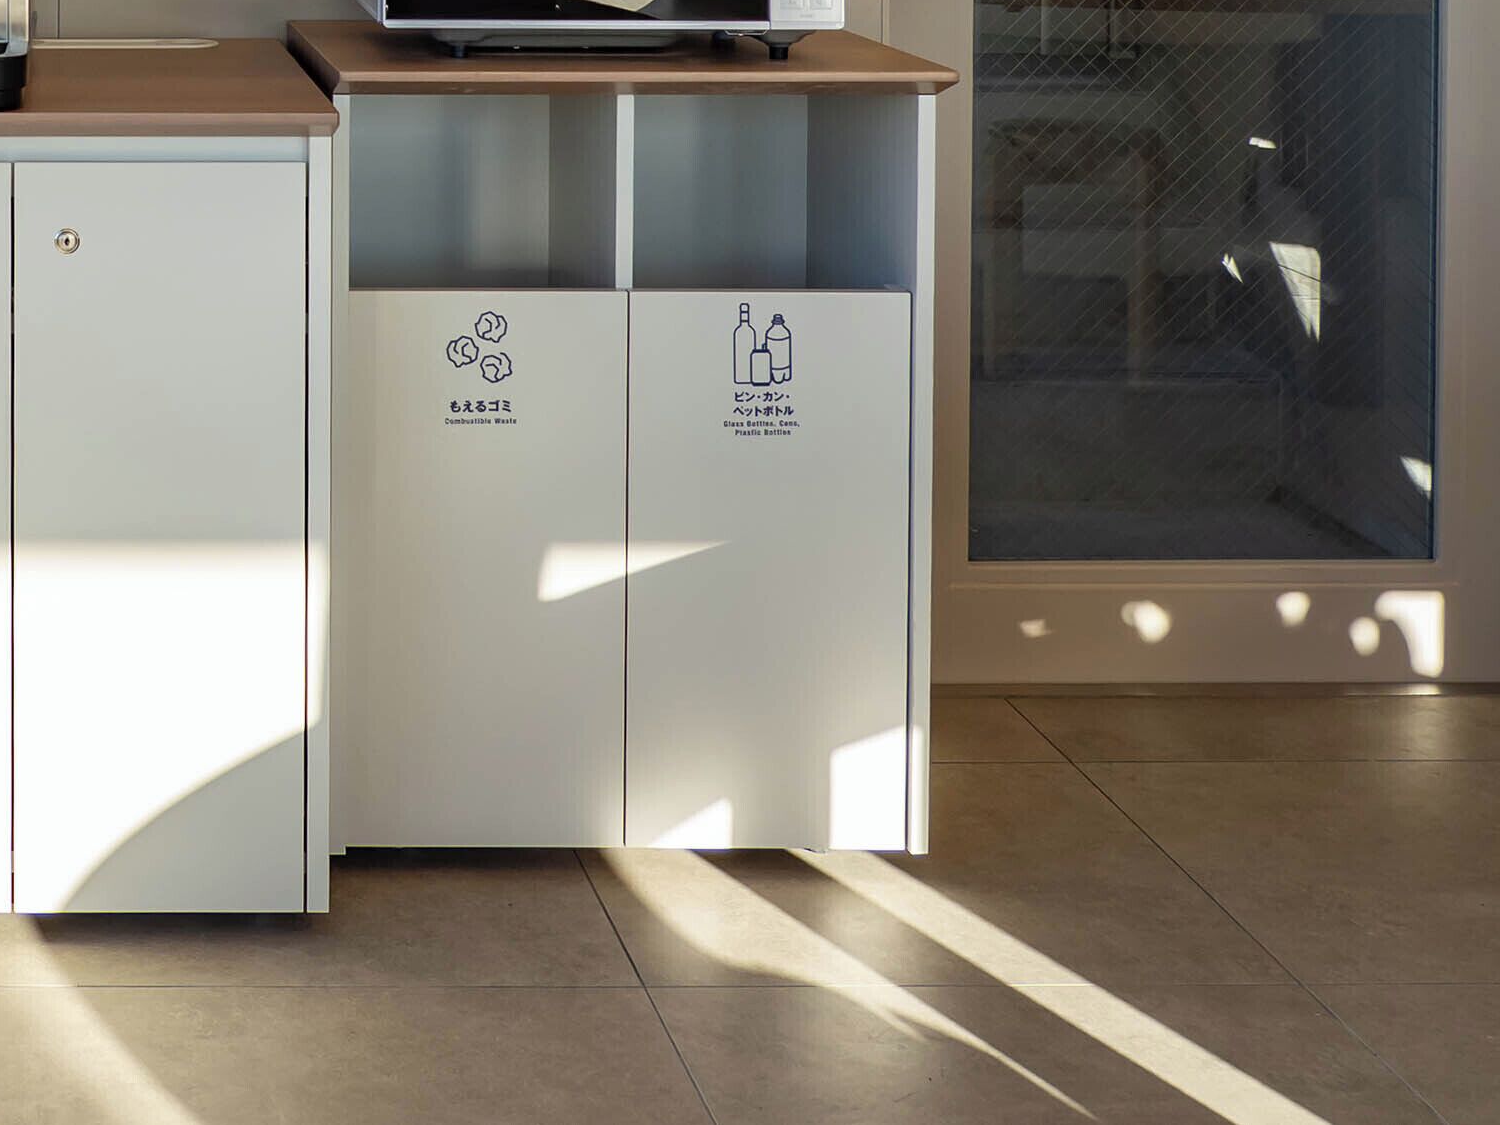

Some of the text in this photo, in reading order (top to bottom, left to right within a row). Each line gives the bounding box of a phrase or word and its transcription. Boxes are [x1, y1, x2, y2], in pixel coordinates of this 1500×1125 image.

[450, 400, 512, 413] もえるゴミ
[733, 405, 794, 417] ペットボトル
